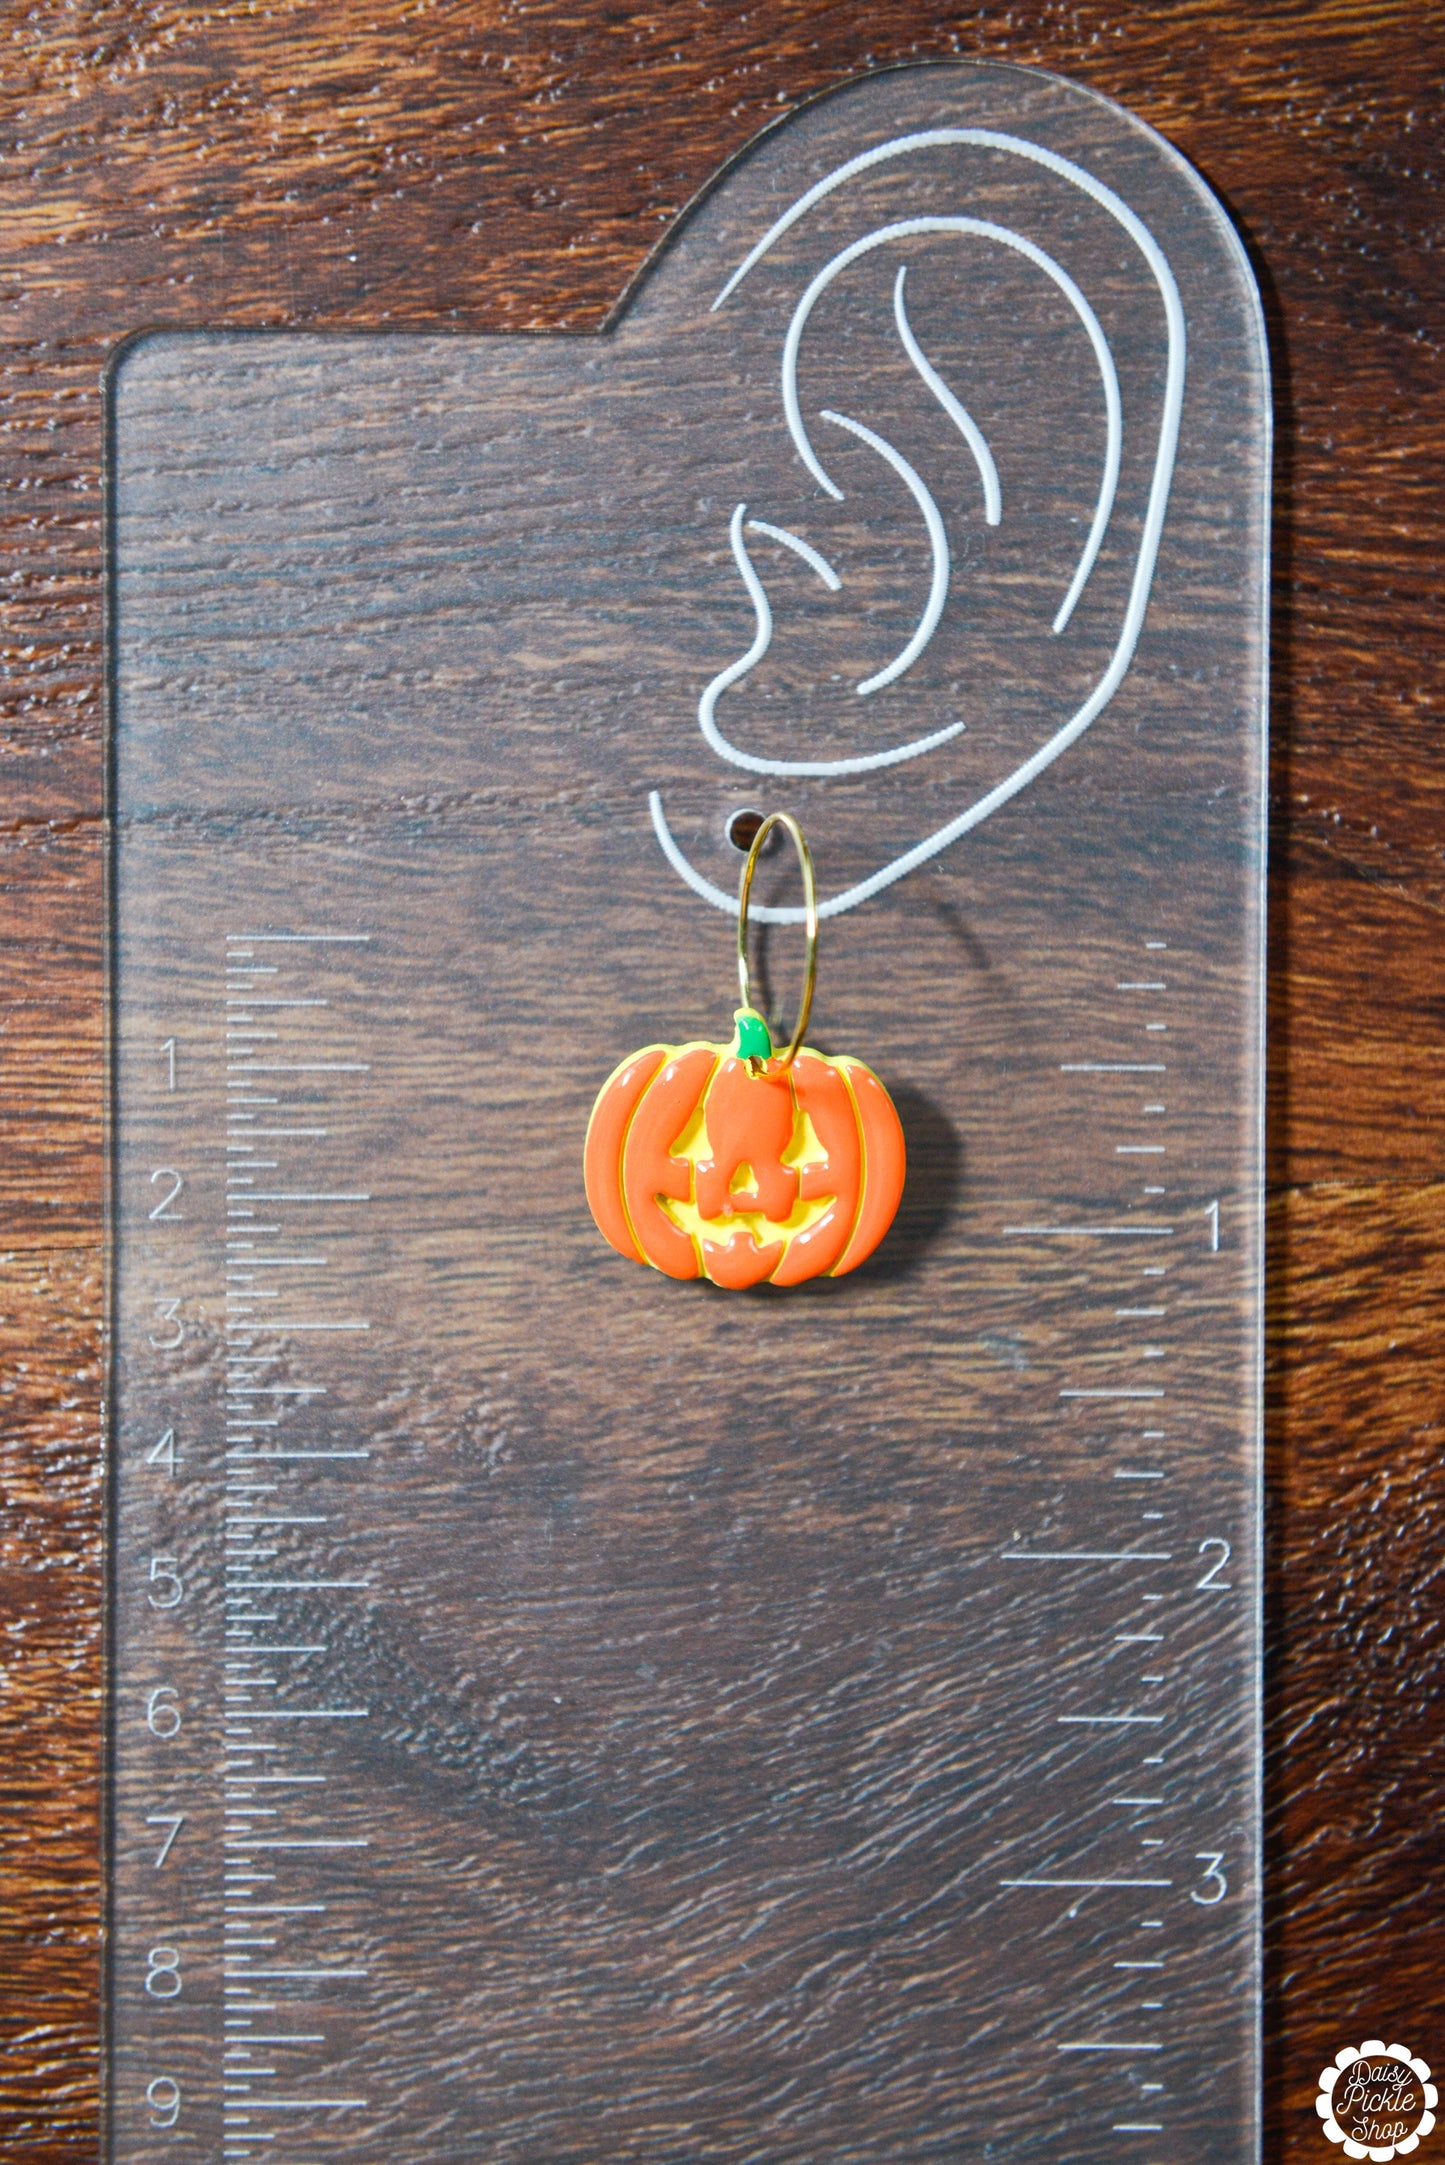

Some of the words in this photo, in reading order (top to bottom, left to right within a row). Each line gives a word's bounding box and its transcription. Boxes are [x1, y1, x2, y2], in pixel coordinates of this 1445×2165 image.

[159, 1037, 177, 1091] 1
[147, 1169, 184, 1219] 2
[1204, 1200, 1219, 1252] 1
[148, 1298, 184, 1349] 3
[146, 1428, 185, 1477] 4
[148, 1557, 183, 1608] 5
[1195, 1537, 1232, 1589] 2
[147, 1687, 181, 1738] 6
[146, 1816, 184, 1868] 7
[1190, 1852, 1228, 1905] 3
[145, 1947, 182, 1998] 8
[146, 2076, 180, 2128] 9
